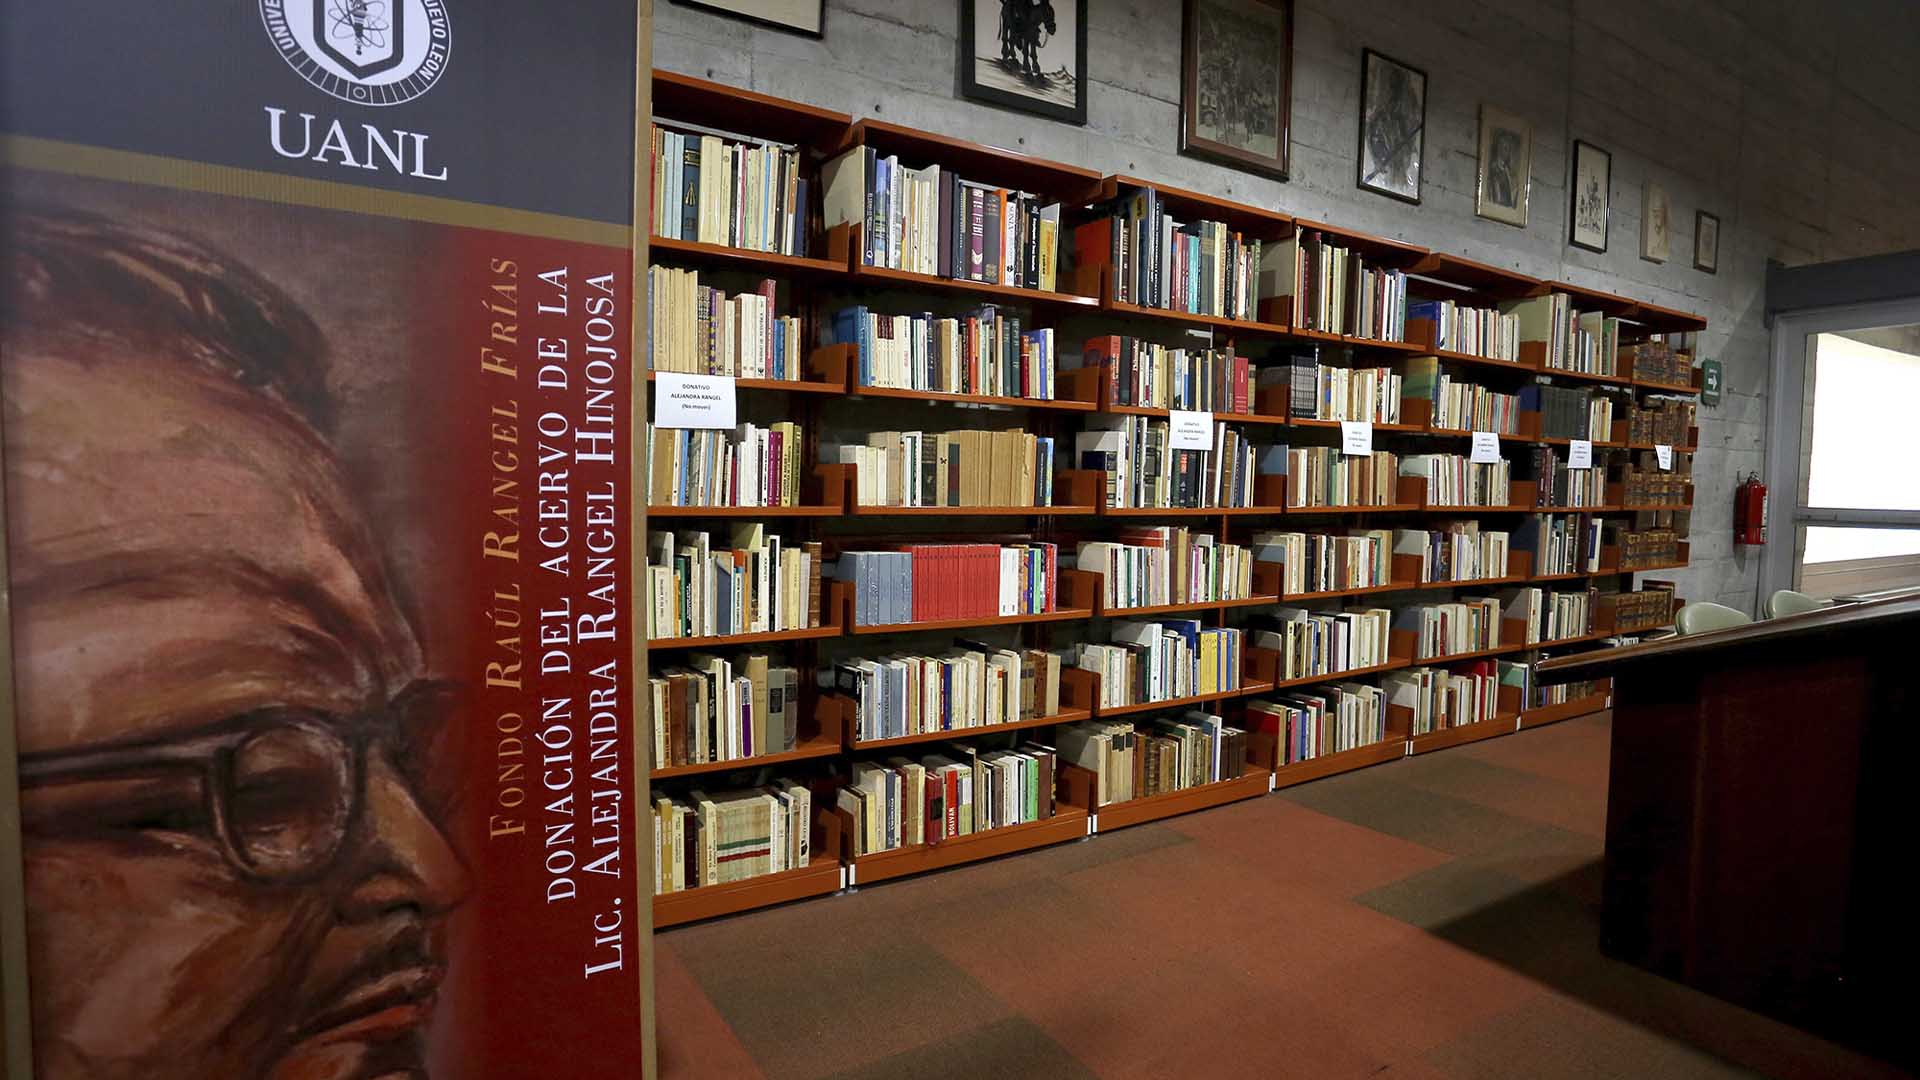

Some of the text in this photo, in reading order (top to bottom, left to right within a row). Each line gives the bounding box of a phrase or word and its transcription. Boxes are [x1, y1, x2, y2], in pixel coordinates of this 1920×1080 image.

[264, 106, 448, 181] UANL
[418, 42, 446, 81] LEON
[480, 257, 526, 840] FONDO RAÚL RANGEL FRÍAS
[535, 266, 576, 904] DONACIÓN DEL ACERVO DE LA
[574, 272, 623, 979] LIC. ALEJANDRA RANGEL HINOJOSA
